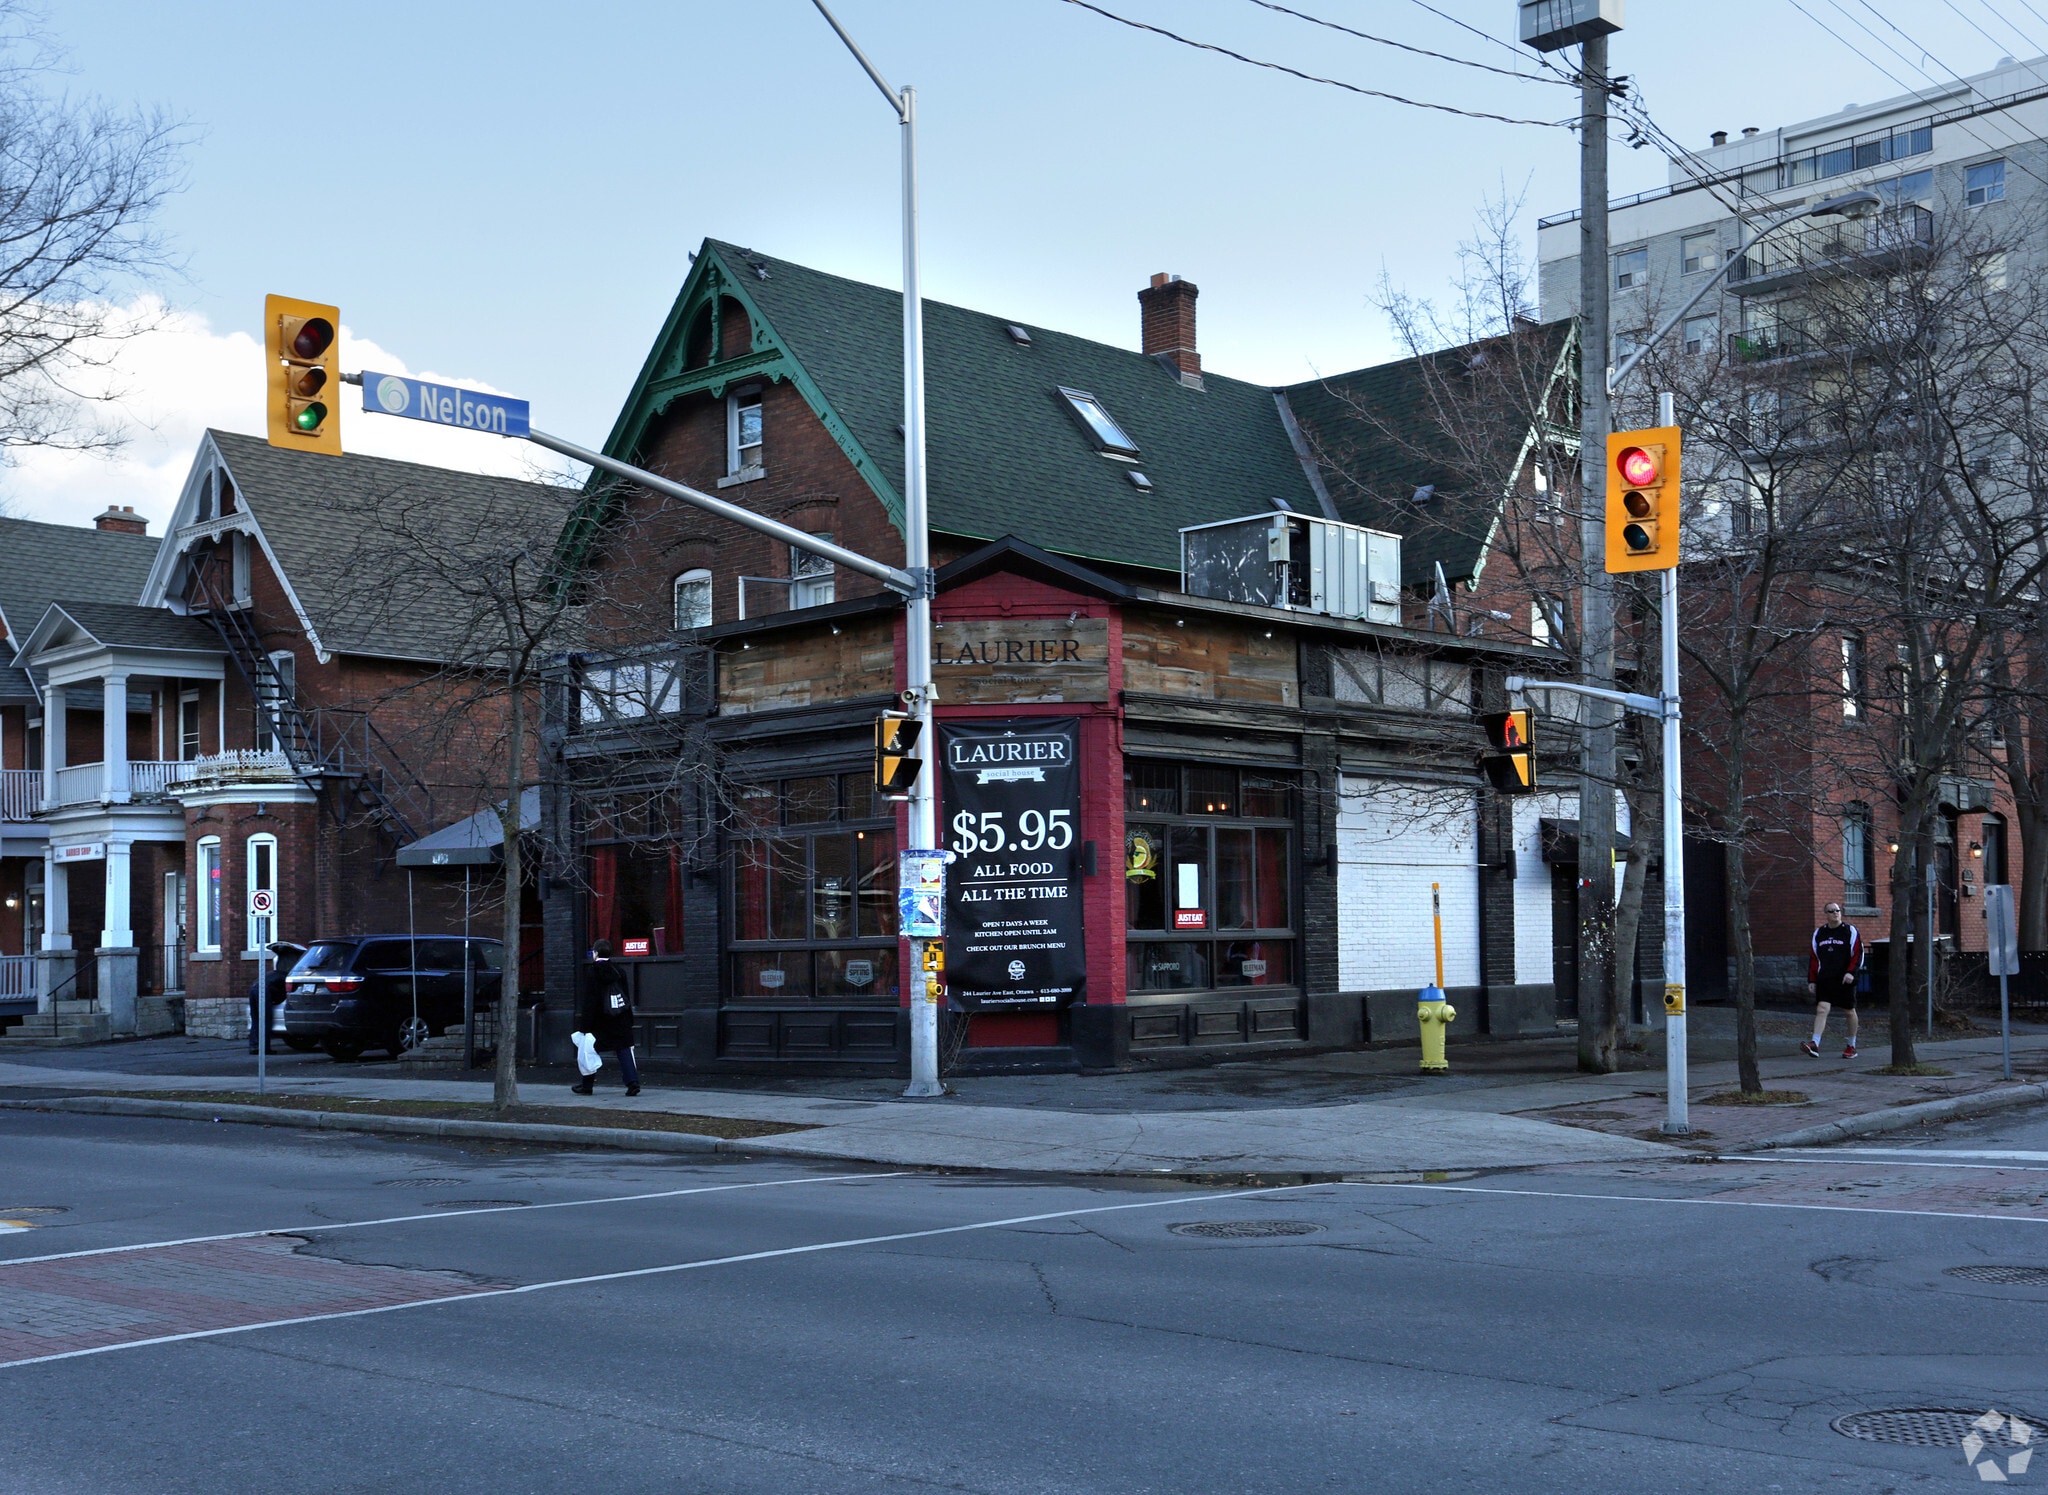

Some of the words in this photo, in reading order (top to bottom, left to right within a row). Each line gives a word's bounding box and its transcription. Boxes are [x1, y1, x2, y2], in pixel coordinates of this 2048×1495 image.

[420, 385, 507, 432] Nelson
[936, 639, 1082, 664] LAURIER
[954, 742, 1066, 763] LAURIER
[952, 809, 1073, 859] $5.95
[973, 865, 1005, 877] ALL
[1009, 862, 1053, 876] FOOD
[960, 889, 992, 902] ALL
[994, 888, 1026, 900] THE
[1028, 886, 1068, 898] TIME
[974, 930, 1003, 938] KITCHEN
[1158, 962, 1180, 970] SAPPORO
